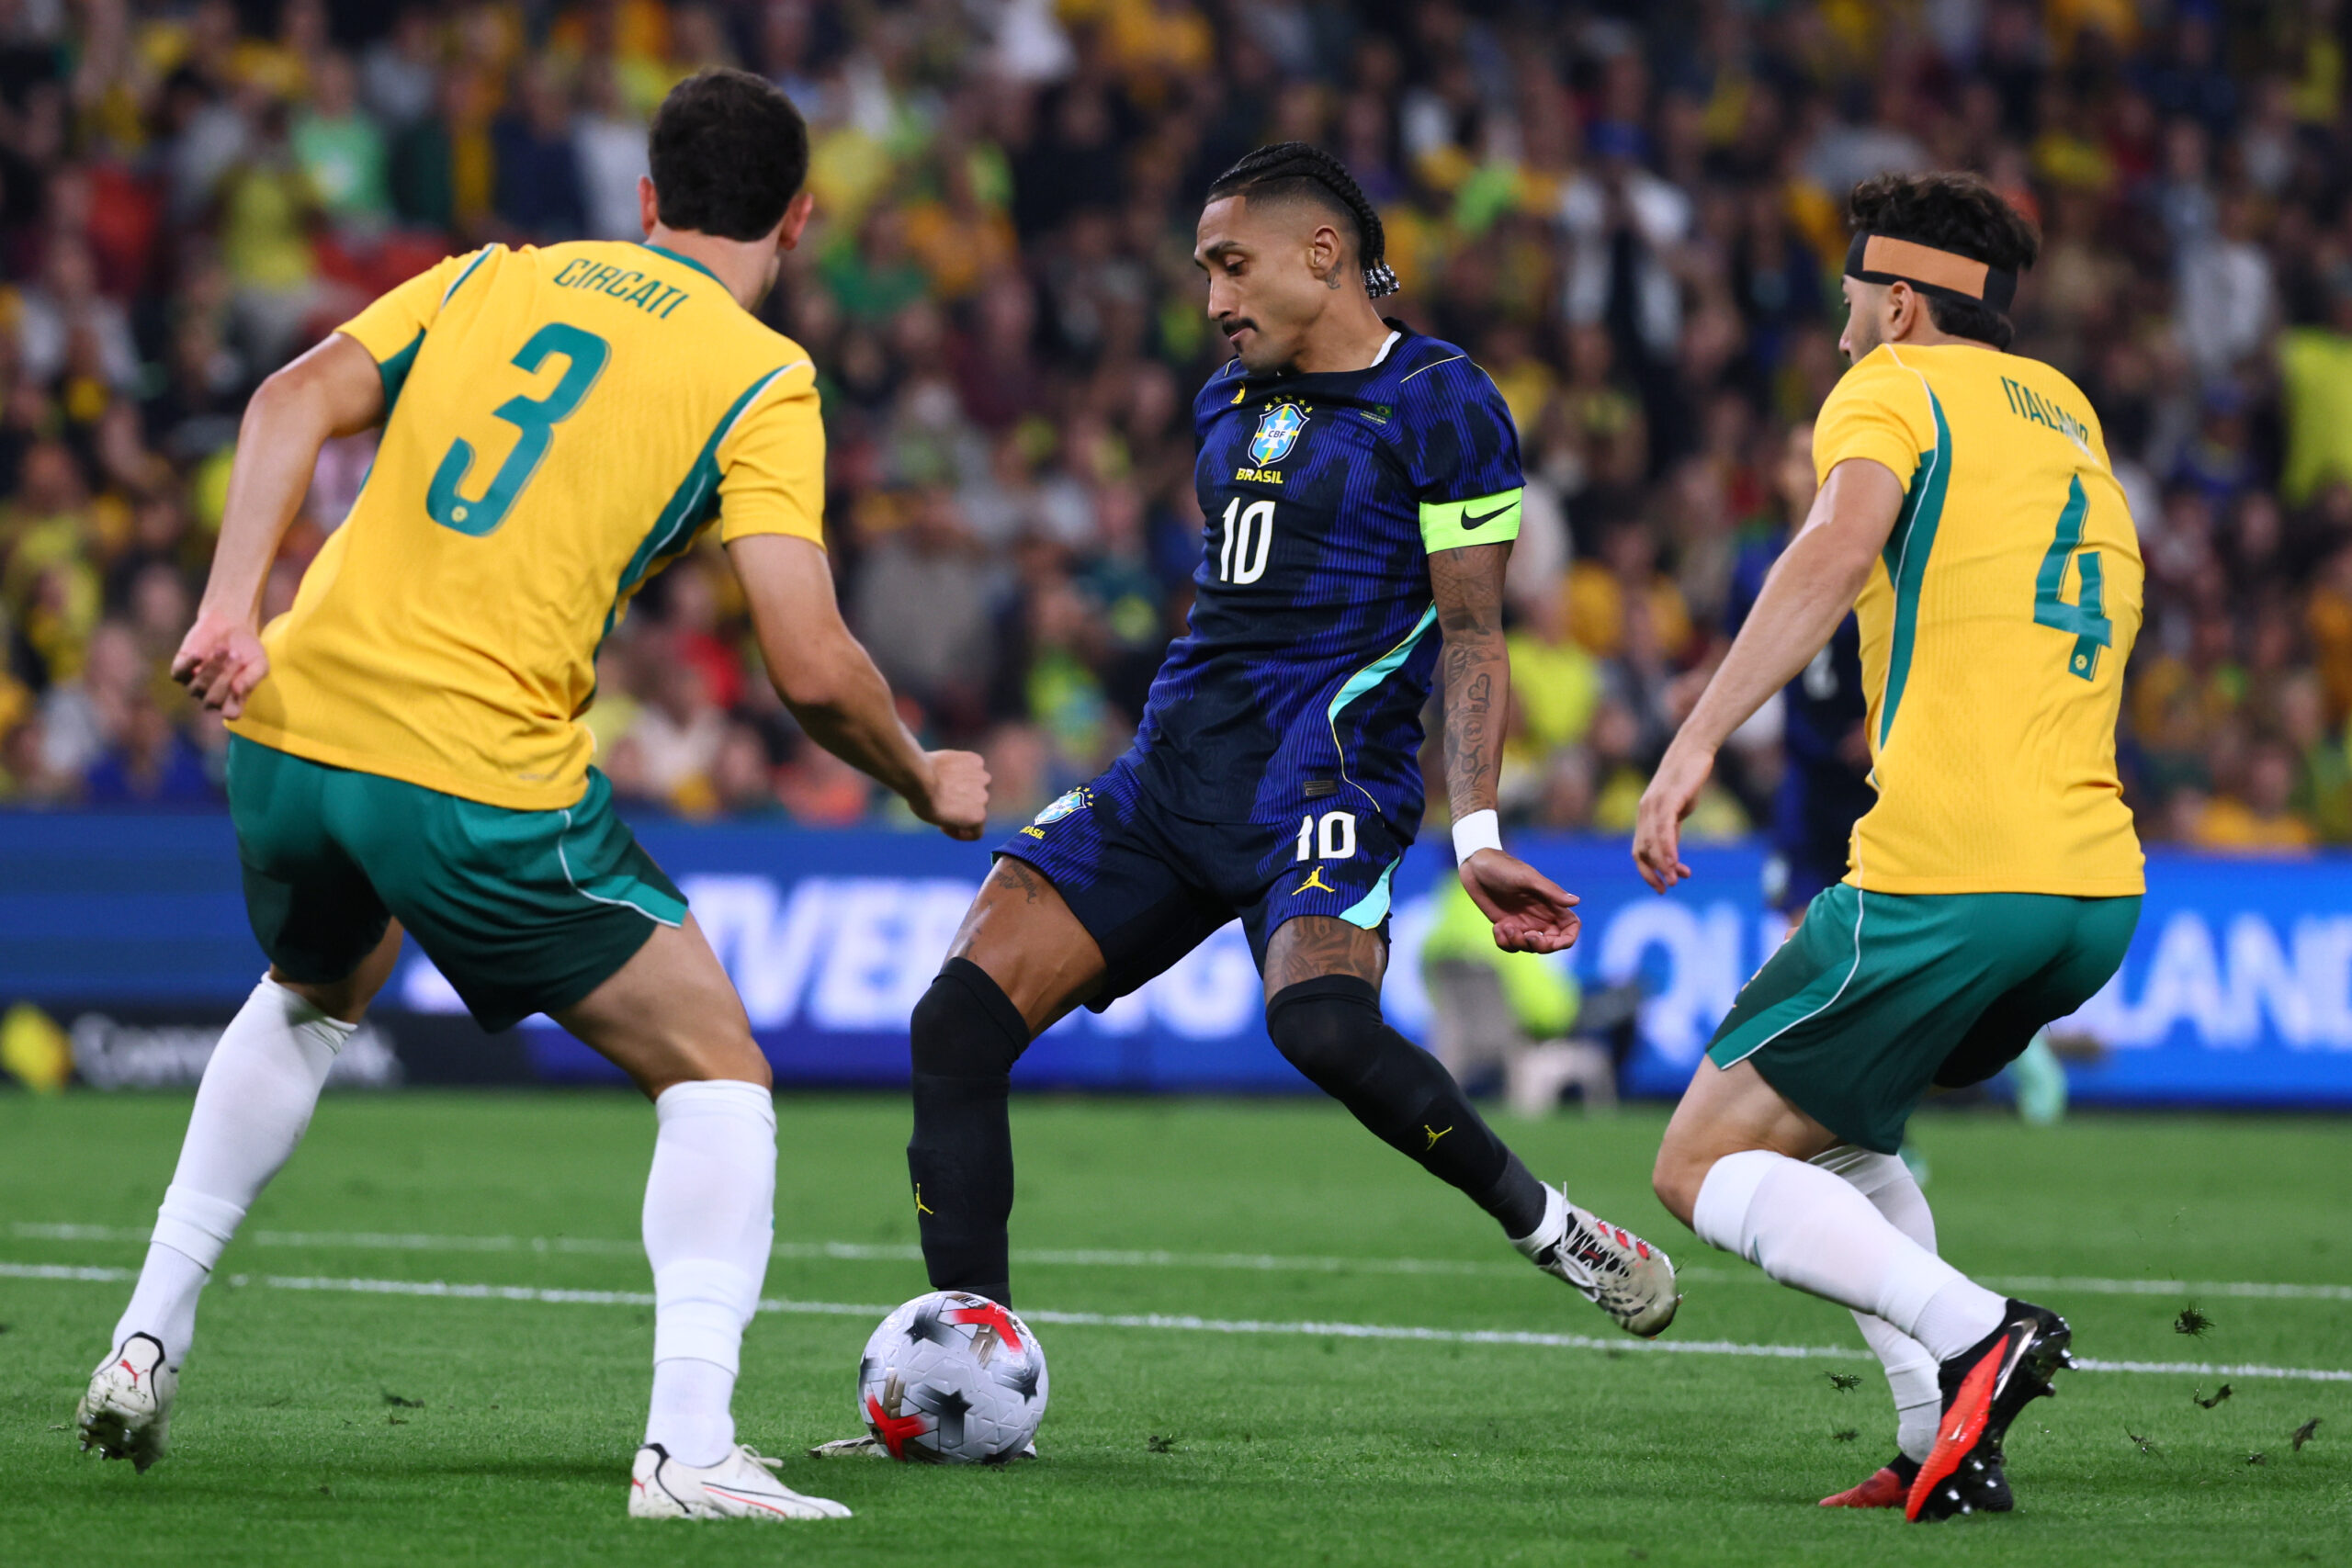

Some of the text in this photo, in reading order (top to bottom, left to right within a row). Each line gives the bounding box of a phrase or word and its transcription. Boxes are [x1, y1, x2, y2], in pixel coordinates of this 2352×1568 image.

[553, 258, 689, 319] CIRCATI
[426, 322, 612, 537] 3
[1268, 429, 1285, 438] CBF
[1236, 468, 1283, 484] BRASIL
[1220, 497, 1275, 584] 10
[2033, 473, 2112, 682] 4
[1296, 811, 1356, 862] 10
